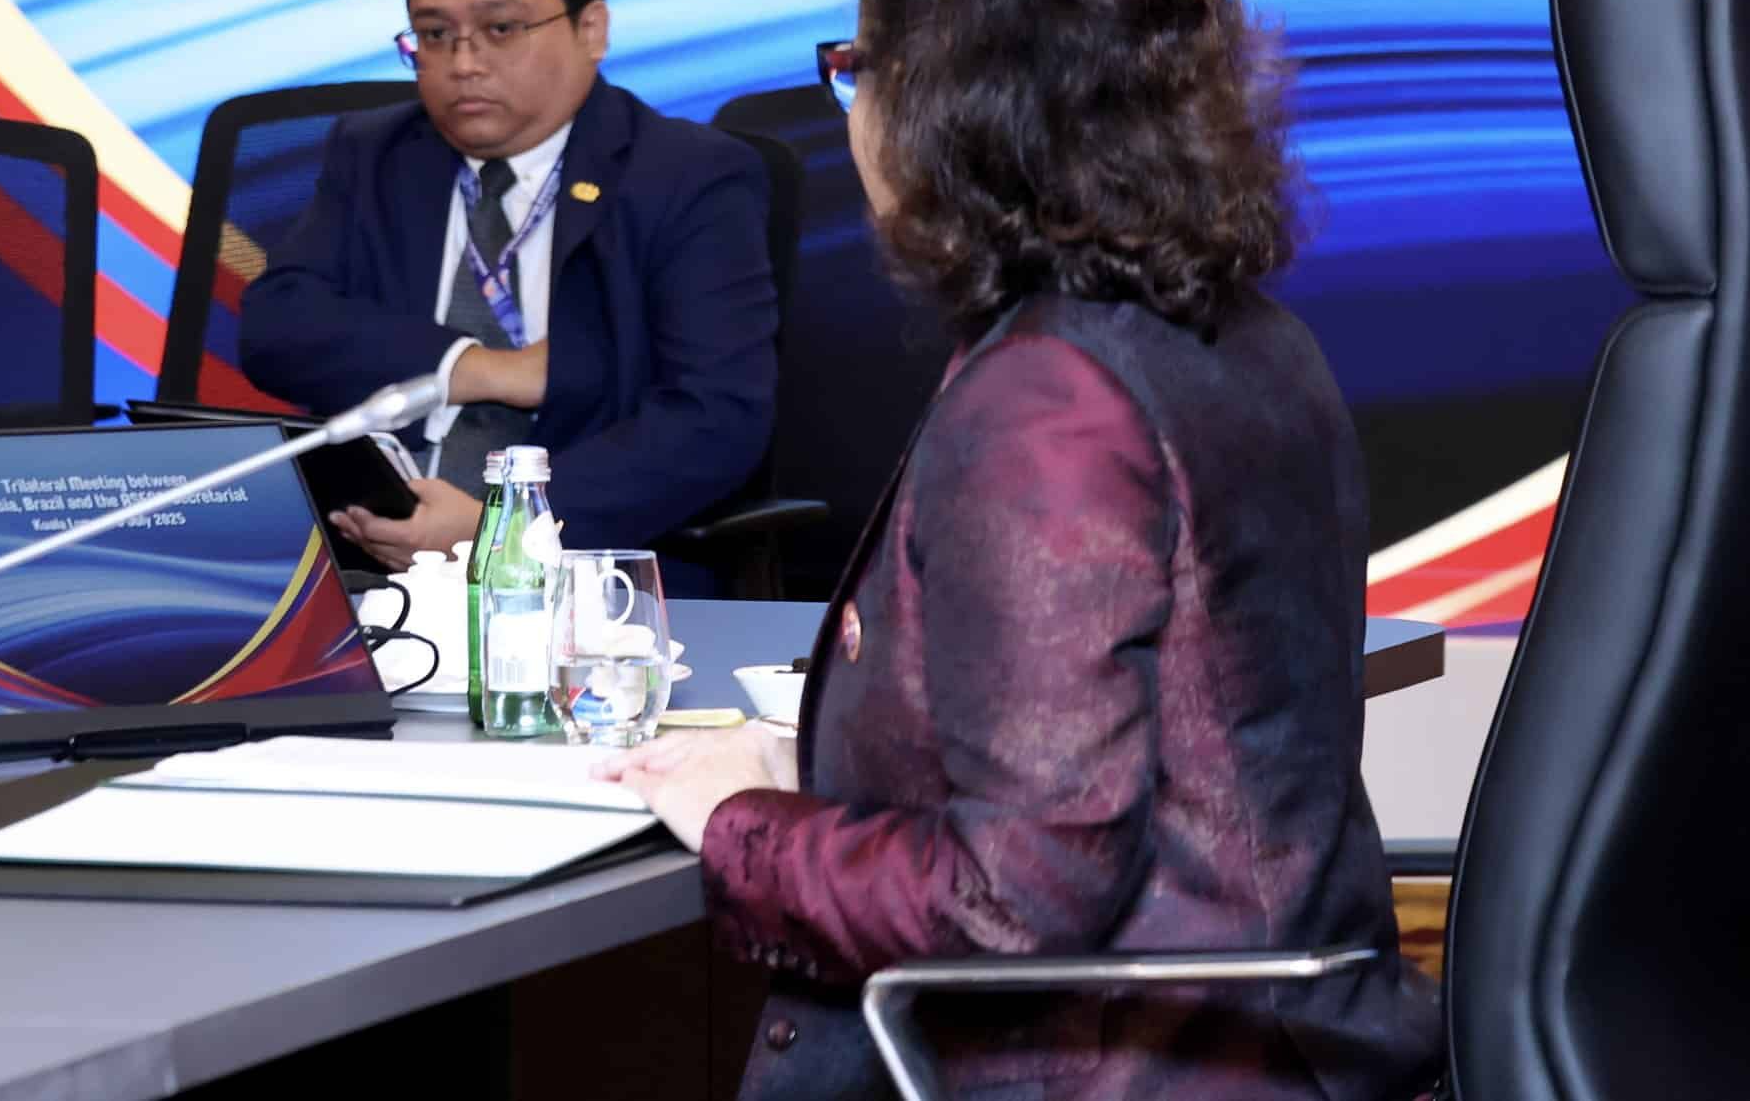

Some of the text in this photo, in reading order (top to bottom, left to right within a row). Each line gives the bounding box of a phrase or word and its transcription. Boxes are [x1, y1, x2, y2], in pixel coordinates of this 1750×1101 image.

[0, 472, 187, 494] Trilateral Meeting between
[23, 493, 65, 512] Brazil
[67, 493, 93, 510] and
[94, 492, 120, 509] the
[153, 511, 186, 527] 2025
